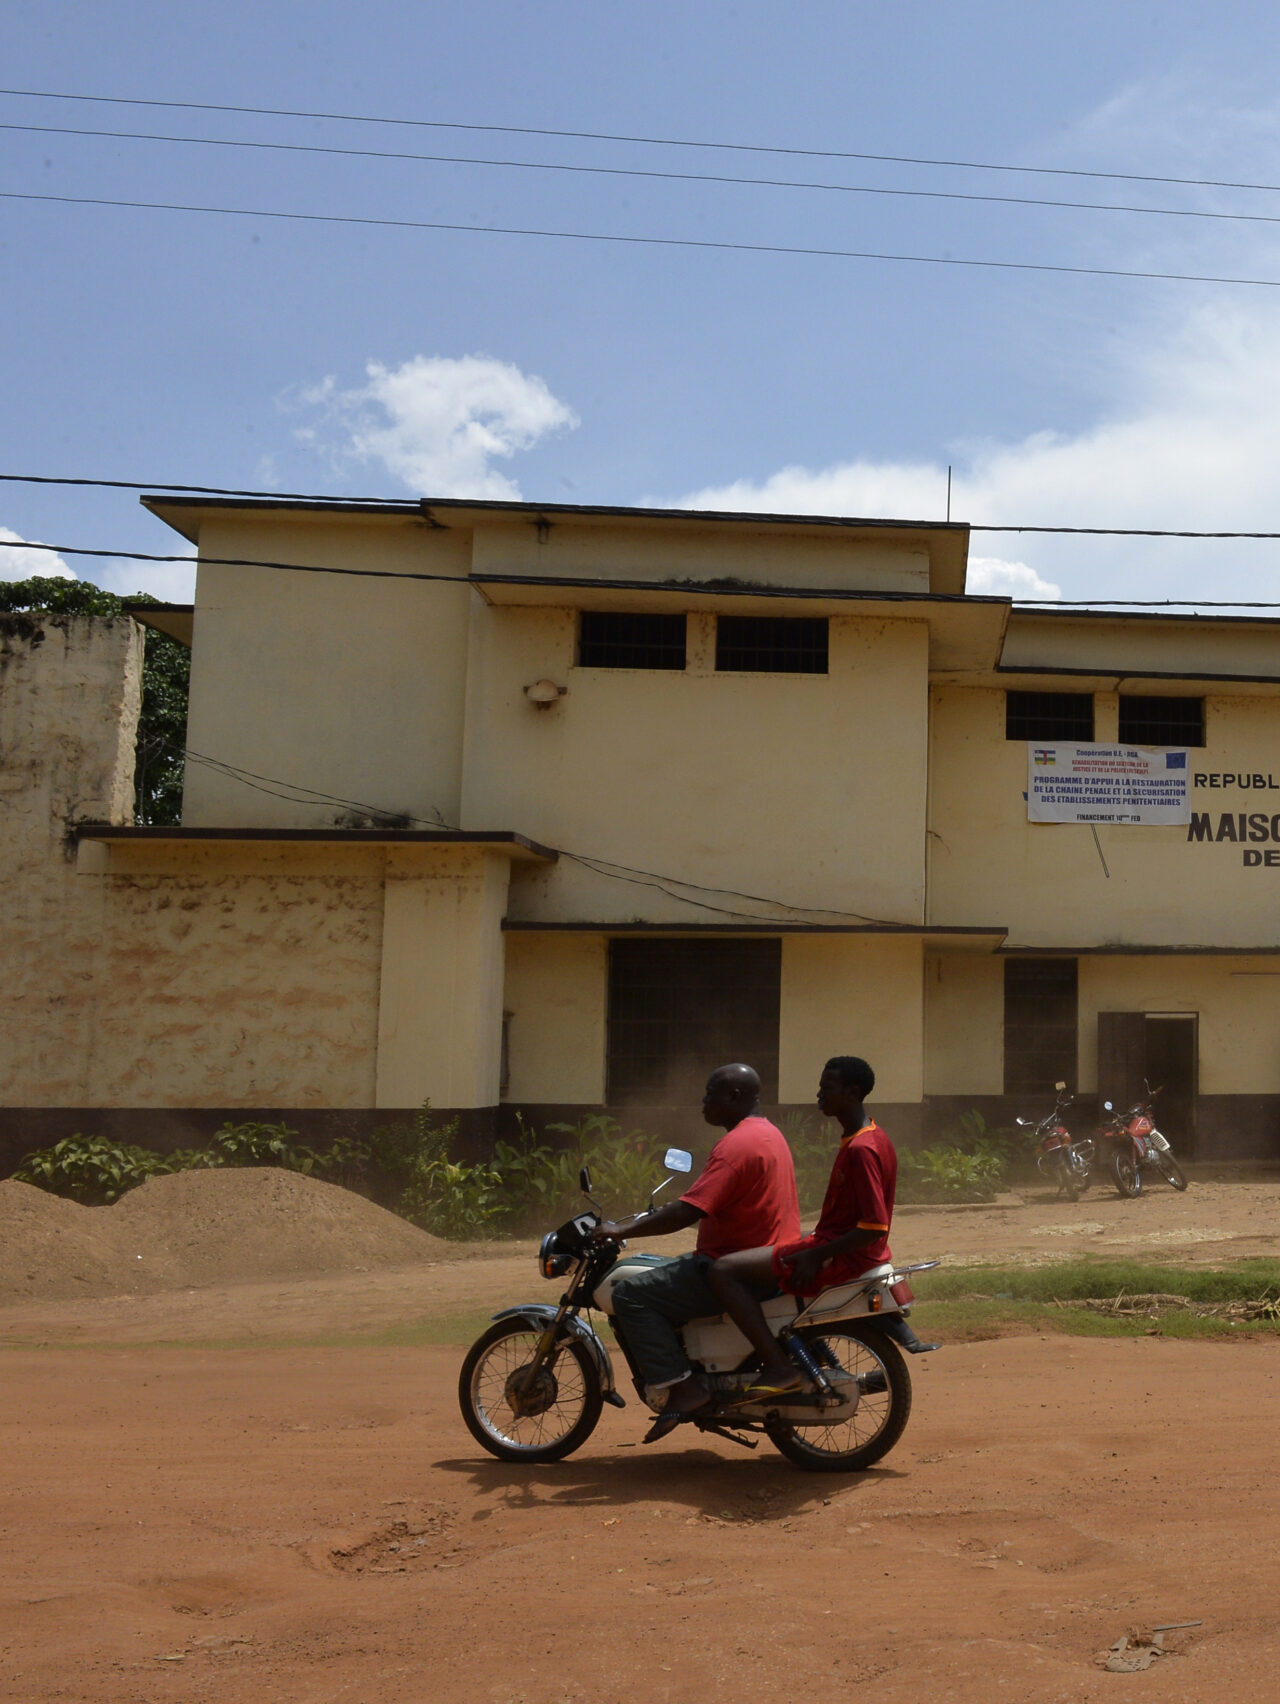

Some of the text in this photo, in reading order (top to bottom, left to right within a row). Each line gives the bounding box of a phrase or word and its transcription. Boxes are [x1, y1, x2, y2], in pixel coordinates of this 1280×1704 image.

[1034, 776, 1082, 785] PROGRAMME
[1084, 777, 1114, 785] D'APPUI
[1122, 778, 1130, 786] LA
[1132, 778, 1186, 787] RESTAURATION
[1034, 785, 1043, 793] DE
[1055, 786, 1083, 794] CHAINE
[1085, 787, 1111, 795] PENALE
[1133, 788, 1186, 796] SECURISATION
[1041, 795, 1181, 806] DES ETABLISSEMENTS PENITENTIAIRES
[1076, 813, 1115, 821] FINANCEMENT
[1243, 849, 1280, 867] DE
